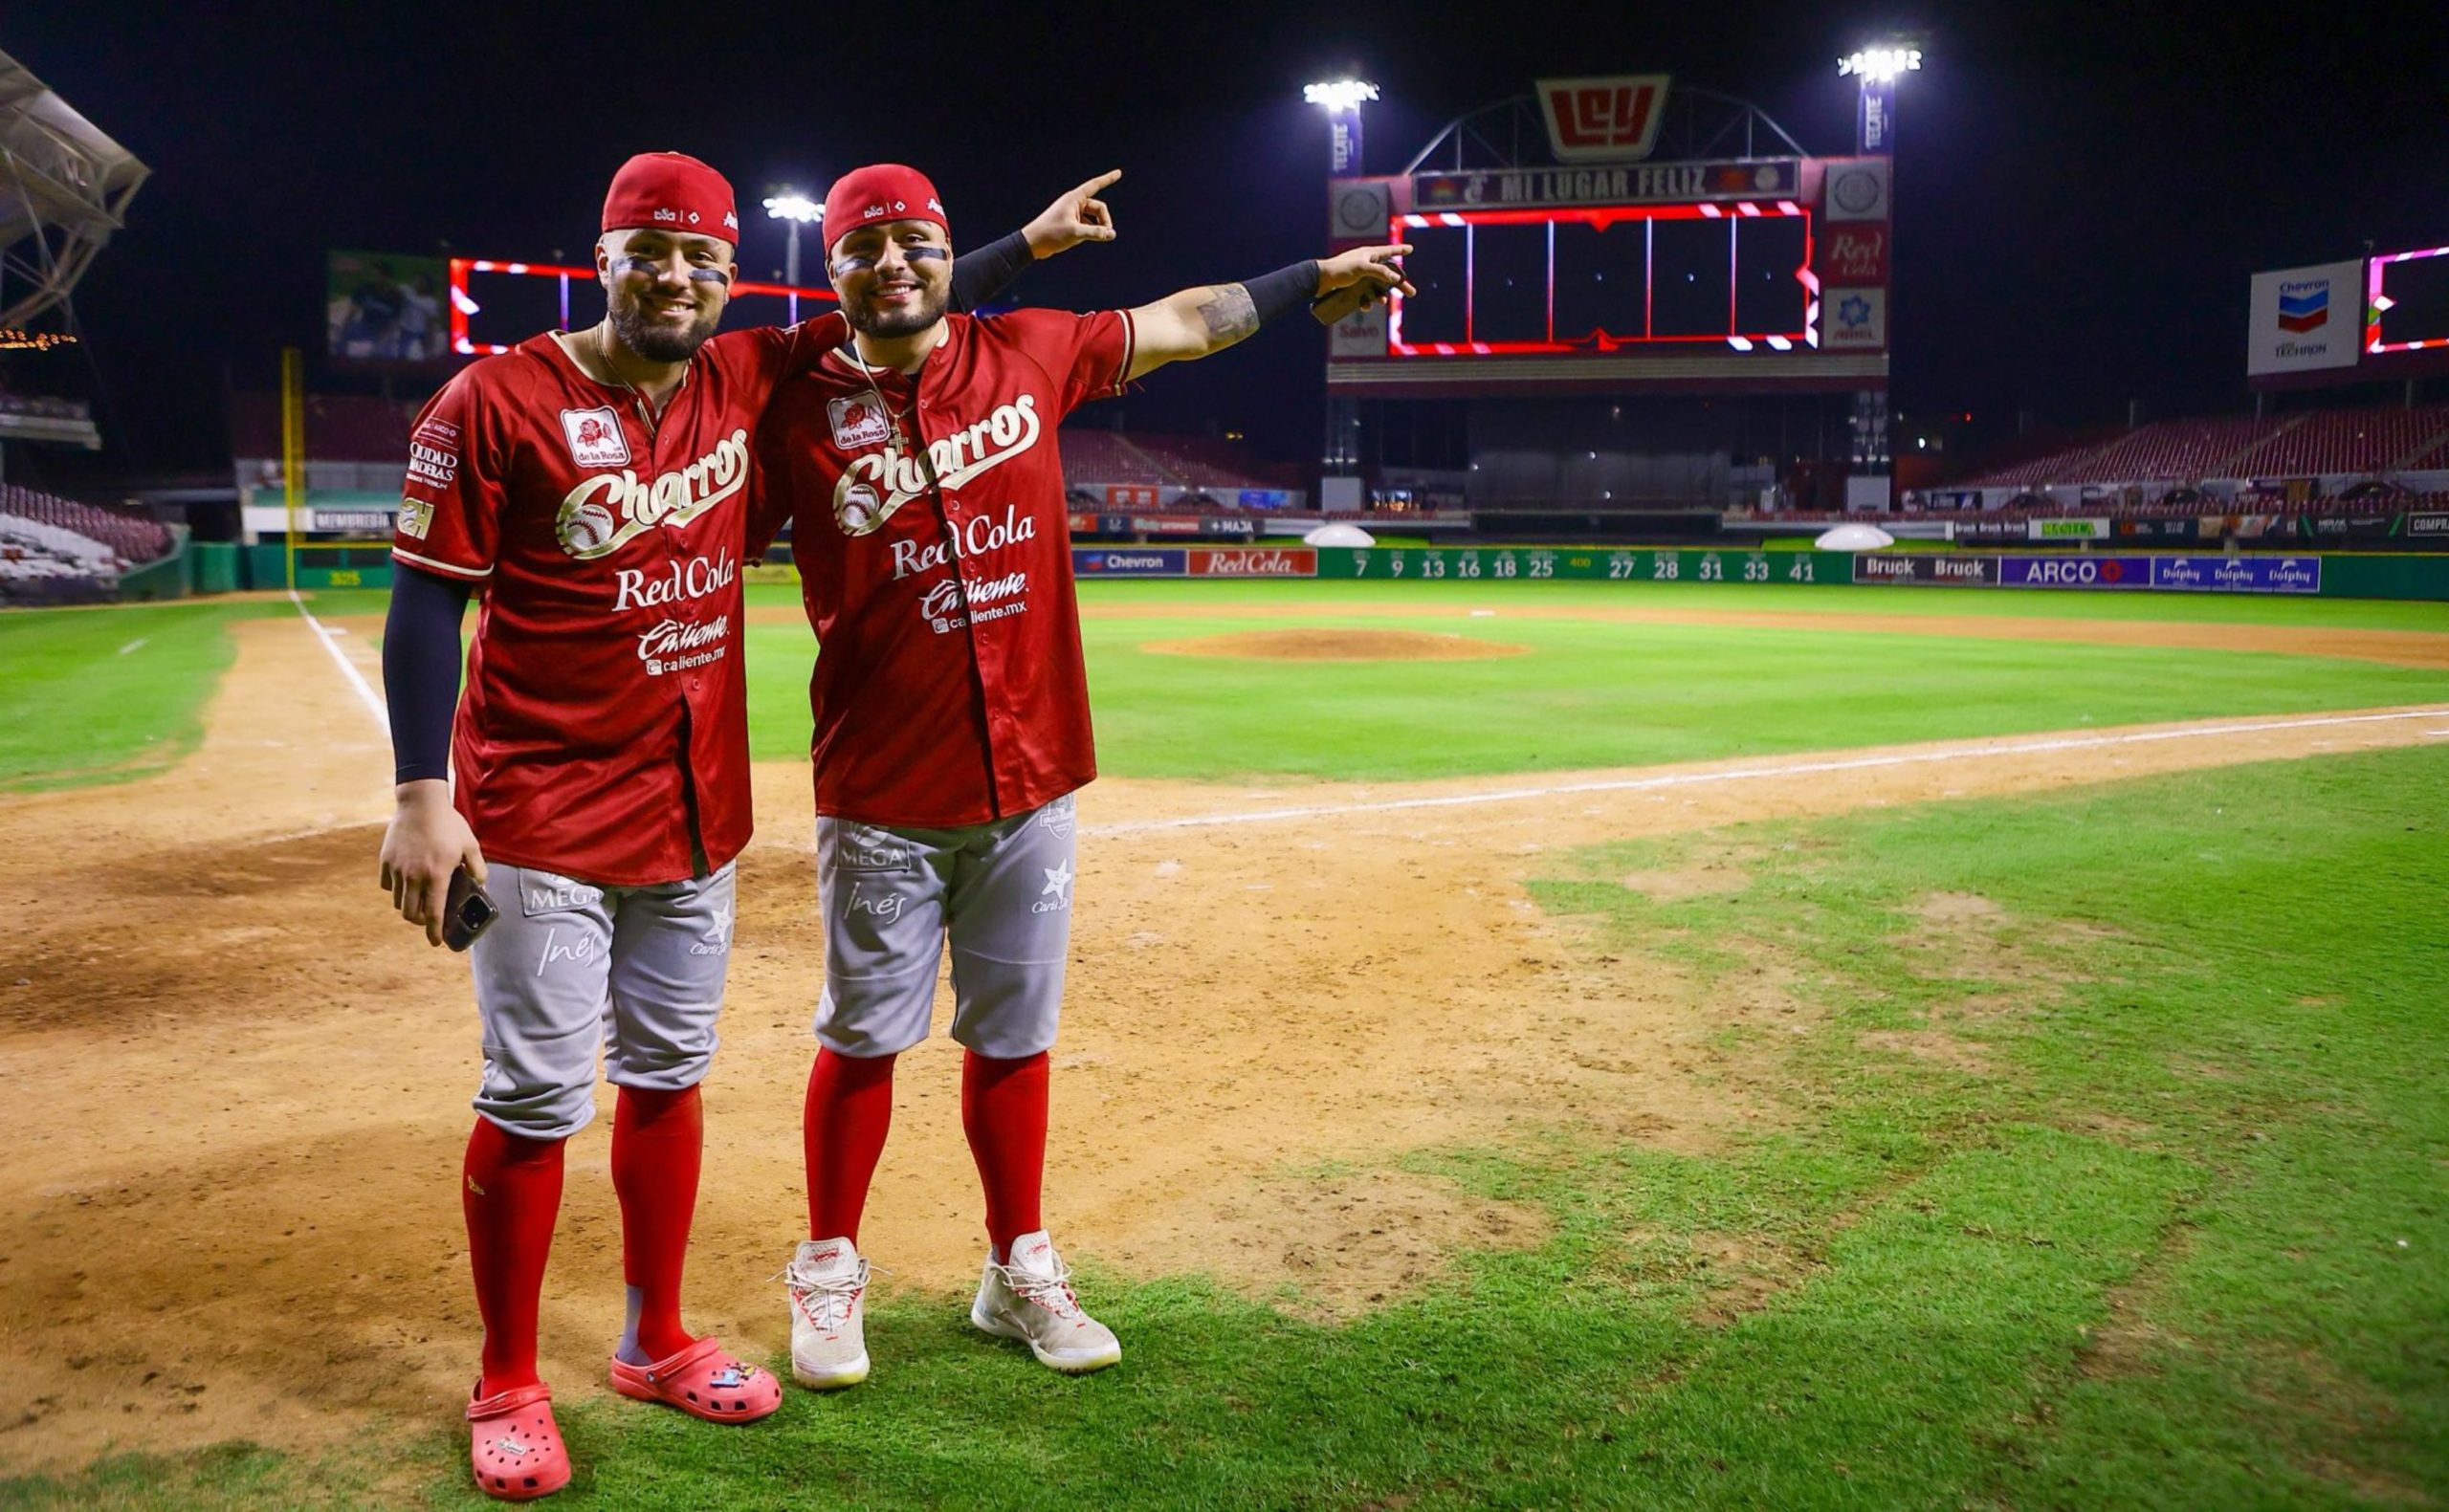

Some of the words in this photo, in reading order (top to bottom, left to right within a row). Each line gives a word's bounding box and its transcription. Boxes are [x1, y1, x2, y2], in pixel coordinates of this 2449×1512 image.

[1501, 173, 1532, 202] MI
[1542, 169, 1627, 201] LUGAR
[1637, 165, 1707, 196] FELIZ
[2280, 279, 2330, 293] Chevron
[862, 428, 886, 440] Rosa
[600, 450, 626, 460] Rosa
[831, 393, 1042, 537] Charros
[556, 427, 749, 560] Charros
[889, 520, 967, 581] Red
[966, 503, 1036, 556] Cola
[1108, 554, 1163, 569] Chevron
[1208, 551, 1246, 574] Red
[1246, 549, 1291, 574] Cola
[1355, 559, 1368, 578] 7
[1391, 560, 1404, 578] 9
[1422, 560, 1445, 579] 13
[1458, 559, 1481, 579] 16
[1493, 559, 1517, 579] 18
[1530, 559, 1554, 579] 25
[1609, 560, 1635, 579] 27
[1654, 560, 1680, 580] 28
[1699, 561, 1723, 581] 31
[1744, 562, 1769, 581] 33
[1789, 562, 1815, 581] 41
[1866, 558, 1914, 575] Bruck
[1934, 559, 1985, 577] Bruck
[611, 559, 687, 612] Red
[686, 545, 735, 599] Cola
[2026, 561, 2097, 583] ARCO
[2163, 568, 2200, 585] Dolphy
[2215, 569, 2254, 585] Dolphy
[2269, 571, 2311, 587] Dolphy
[841, 848, 903, 866] MEGA
[531, 886, 604, 909] MEGA
[844, 881, 909, 926] Inés
[536, 927, 600, 977] Inés
